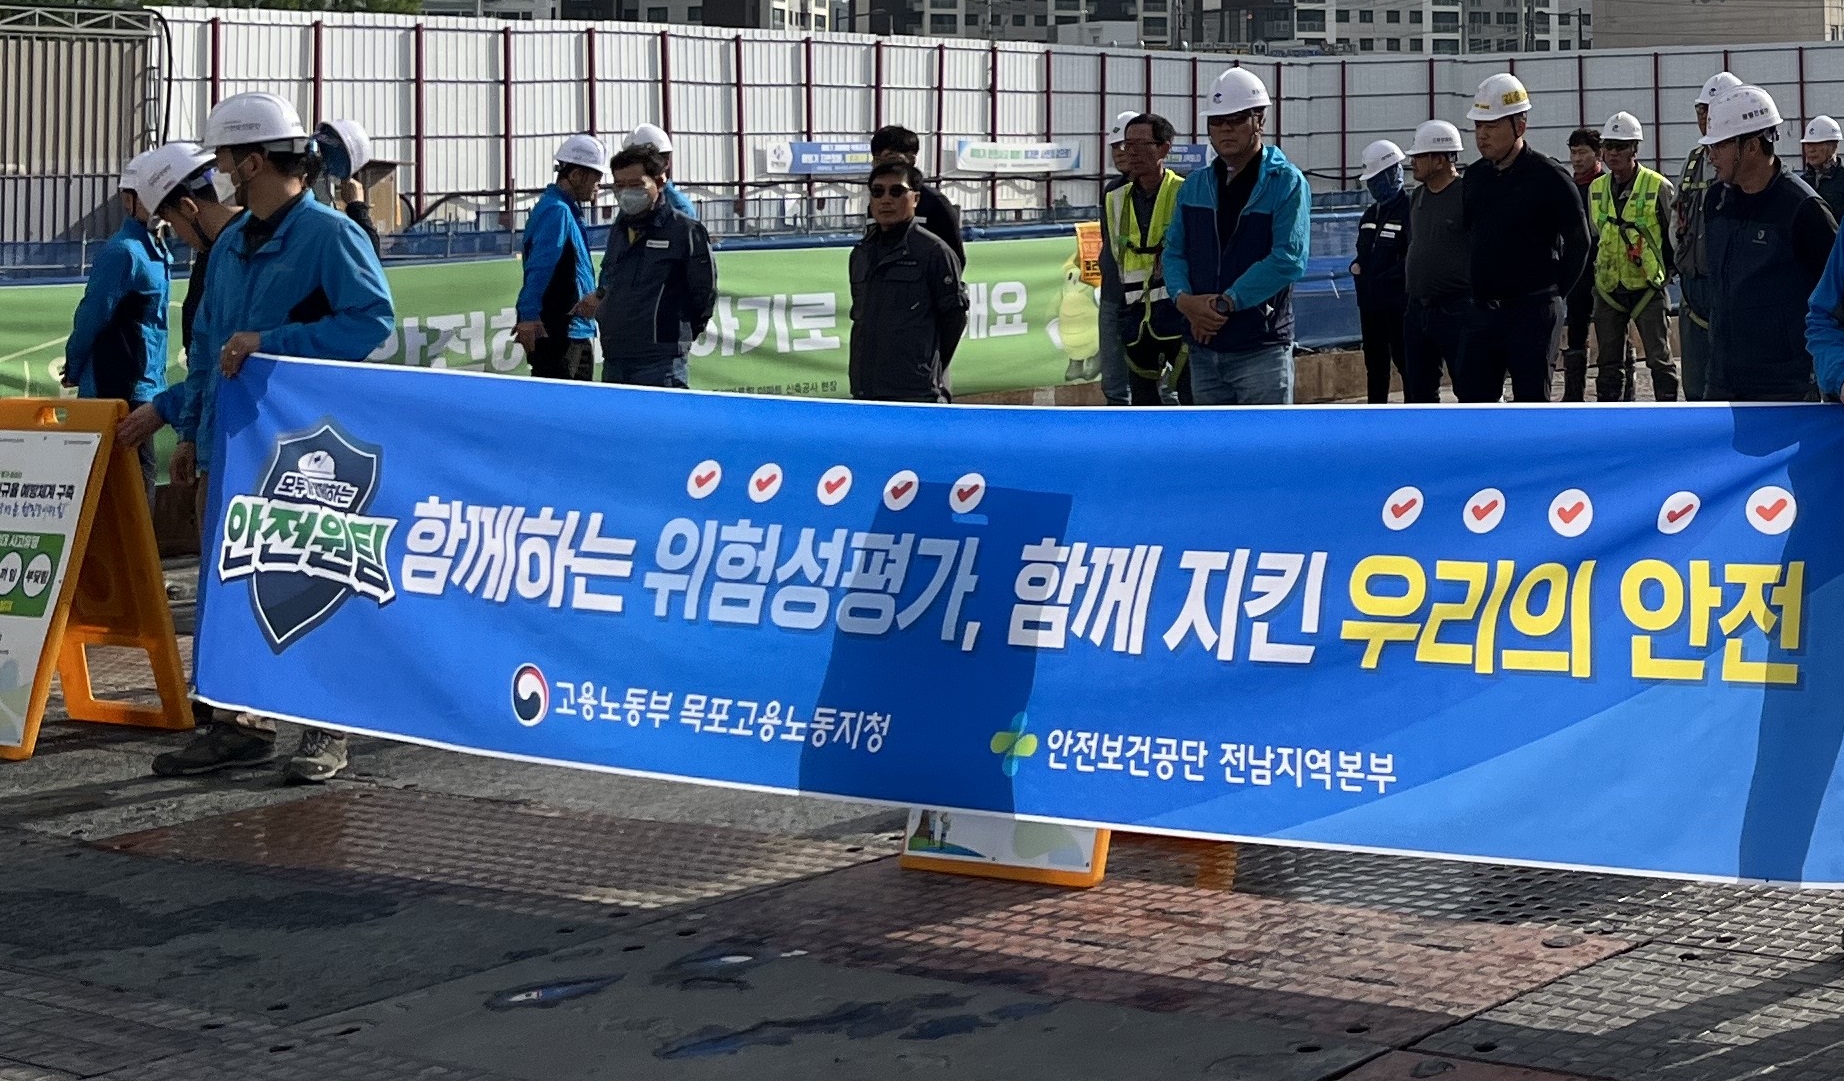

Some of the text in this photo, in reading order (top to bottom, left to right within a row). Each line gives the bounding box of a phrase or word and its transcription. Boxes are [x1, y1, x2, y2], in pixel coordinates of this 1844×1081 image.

[221, 498, 394, 600] 안전원팀
[401, 495, 1804, 684] 함께하는 위험성평가, 함께 지킨 우리의 안전
[555, 680, 892, 753] 고용노동부 목포고용노동지청
[1047, 728, 1397, 794] 안전보건공단 전남지역본부
